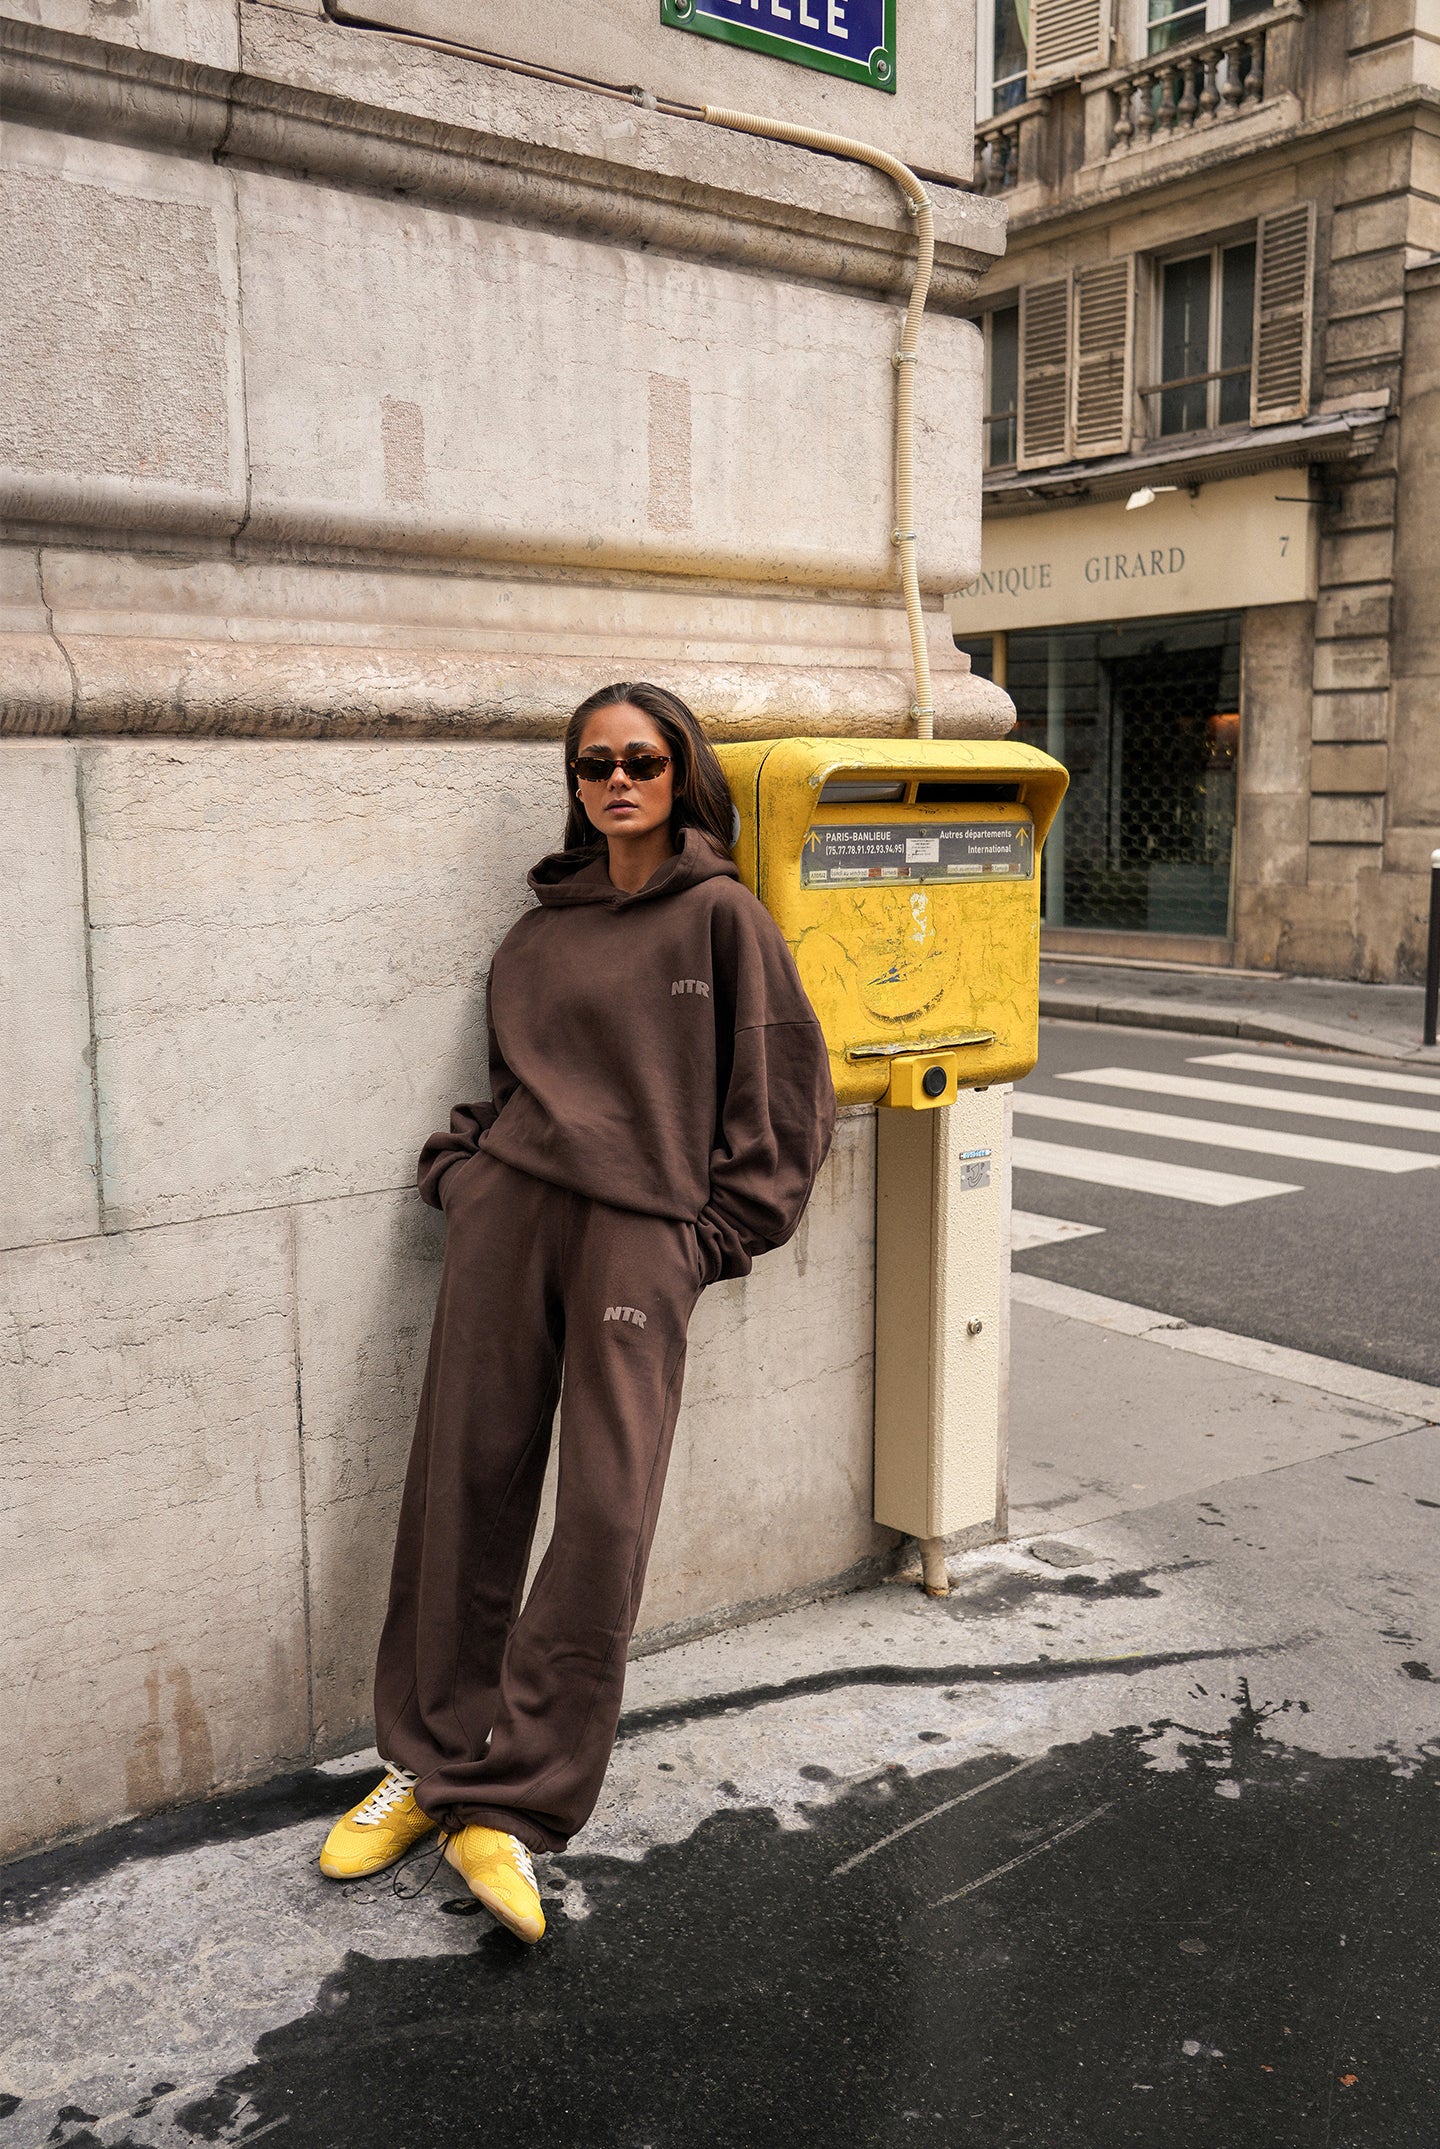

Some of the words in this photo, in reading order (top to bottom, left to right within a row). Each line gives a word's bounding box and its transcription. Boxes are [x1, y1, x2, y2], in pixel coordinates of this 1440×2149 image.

[1279, 536, 1289, 557] 7
[1085, 547, 1185, 584] GIRARD
[825, 831, 891, 842] PARIS-BANLIEUE
[940, 830, 963, 839] Autres
[964, 829, 1012, 840] départements
[825, 843, 905, 856] (75.77.78.91.92.93.94.95)
[967, 844, 1012, 854] International
[671, 979, 710, 998] NTR
[603, 1306, 647, 1329] NTR
